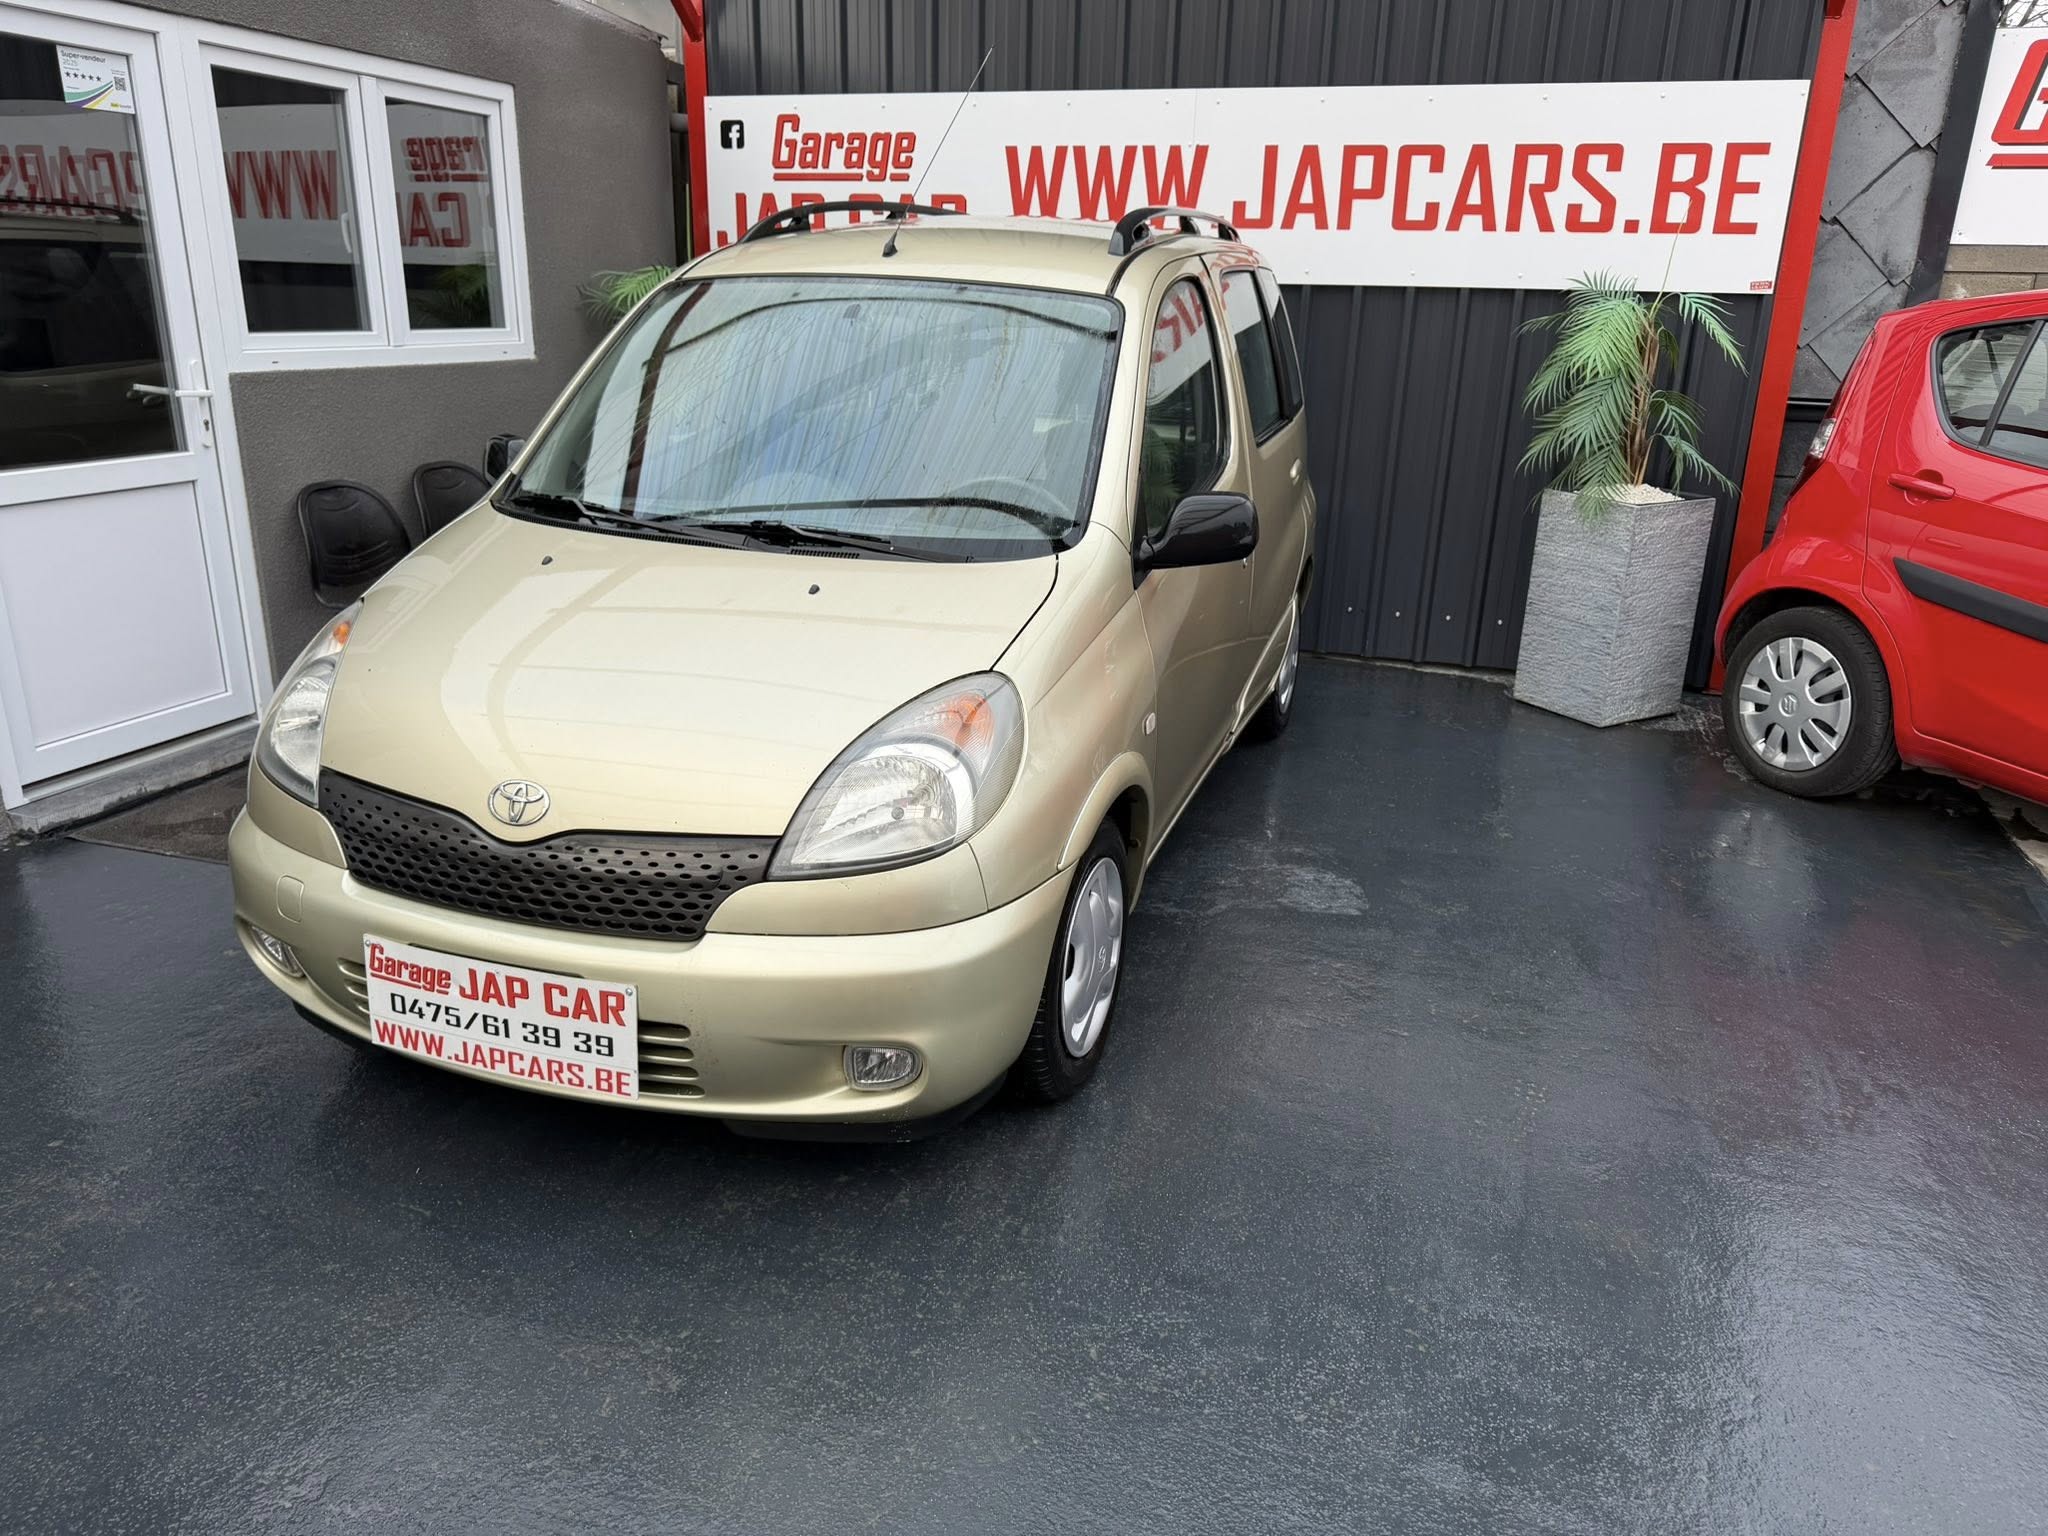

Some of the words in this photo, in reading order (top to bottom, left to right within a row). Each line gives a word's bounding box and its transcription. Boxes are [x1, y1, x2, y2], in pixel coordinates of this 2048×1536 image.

[772, 114, 916, 181] Garage
[368, 943, 451, 993] Garage
[459, 968, 529, 1009] JAP
[543, 982, 626, 1027] CAR
[374, 1019, 631, 1096] WWW.JAPCARS.BE
[390, 992, 510, 1038] 0475/61
[521, 1022, 561, 1049] 39
[573, 1031, 614, 1058] 39
